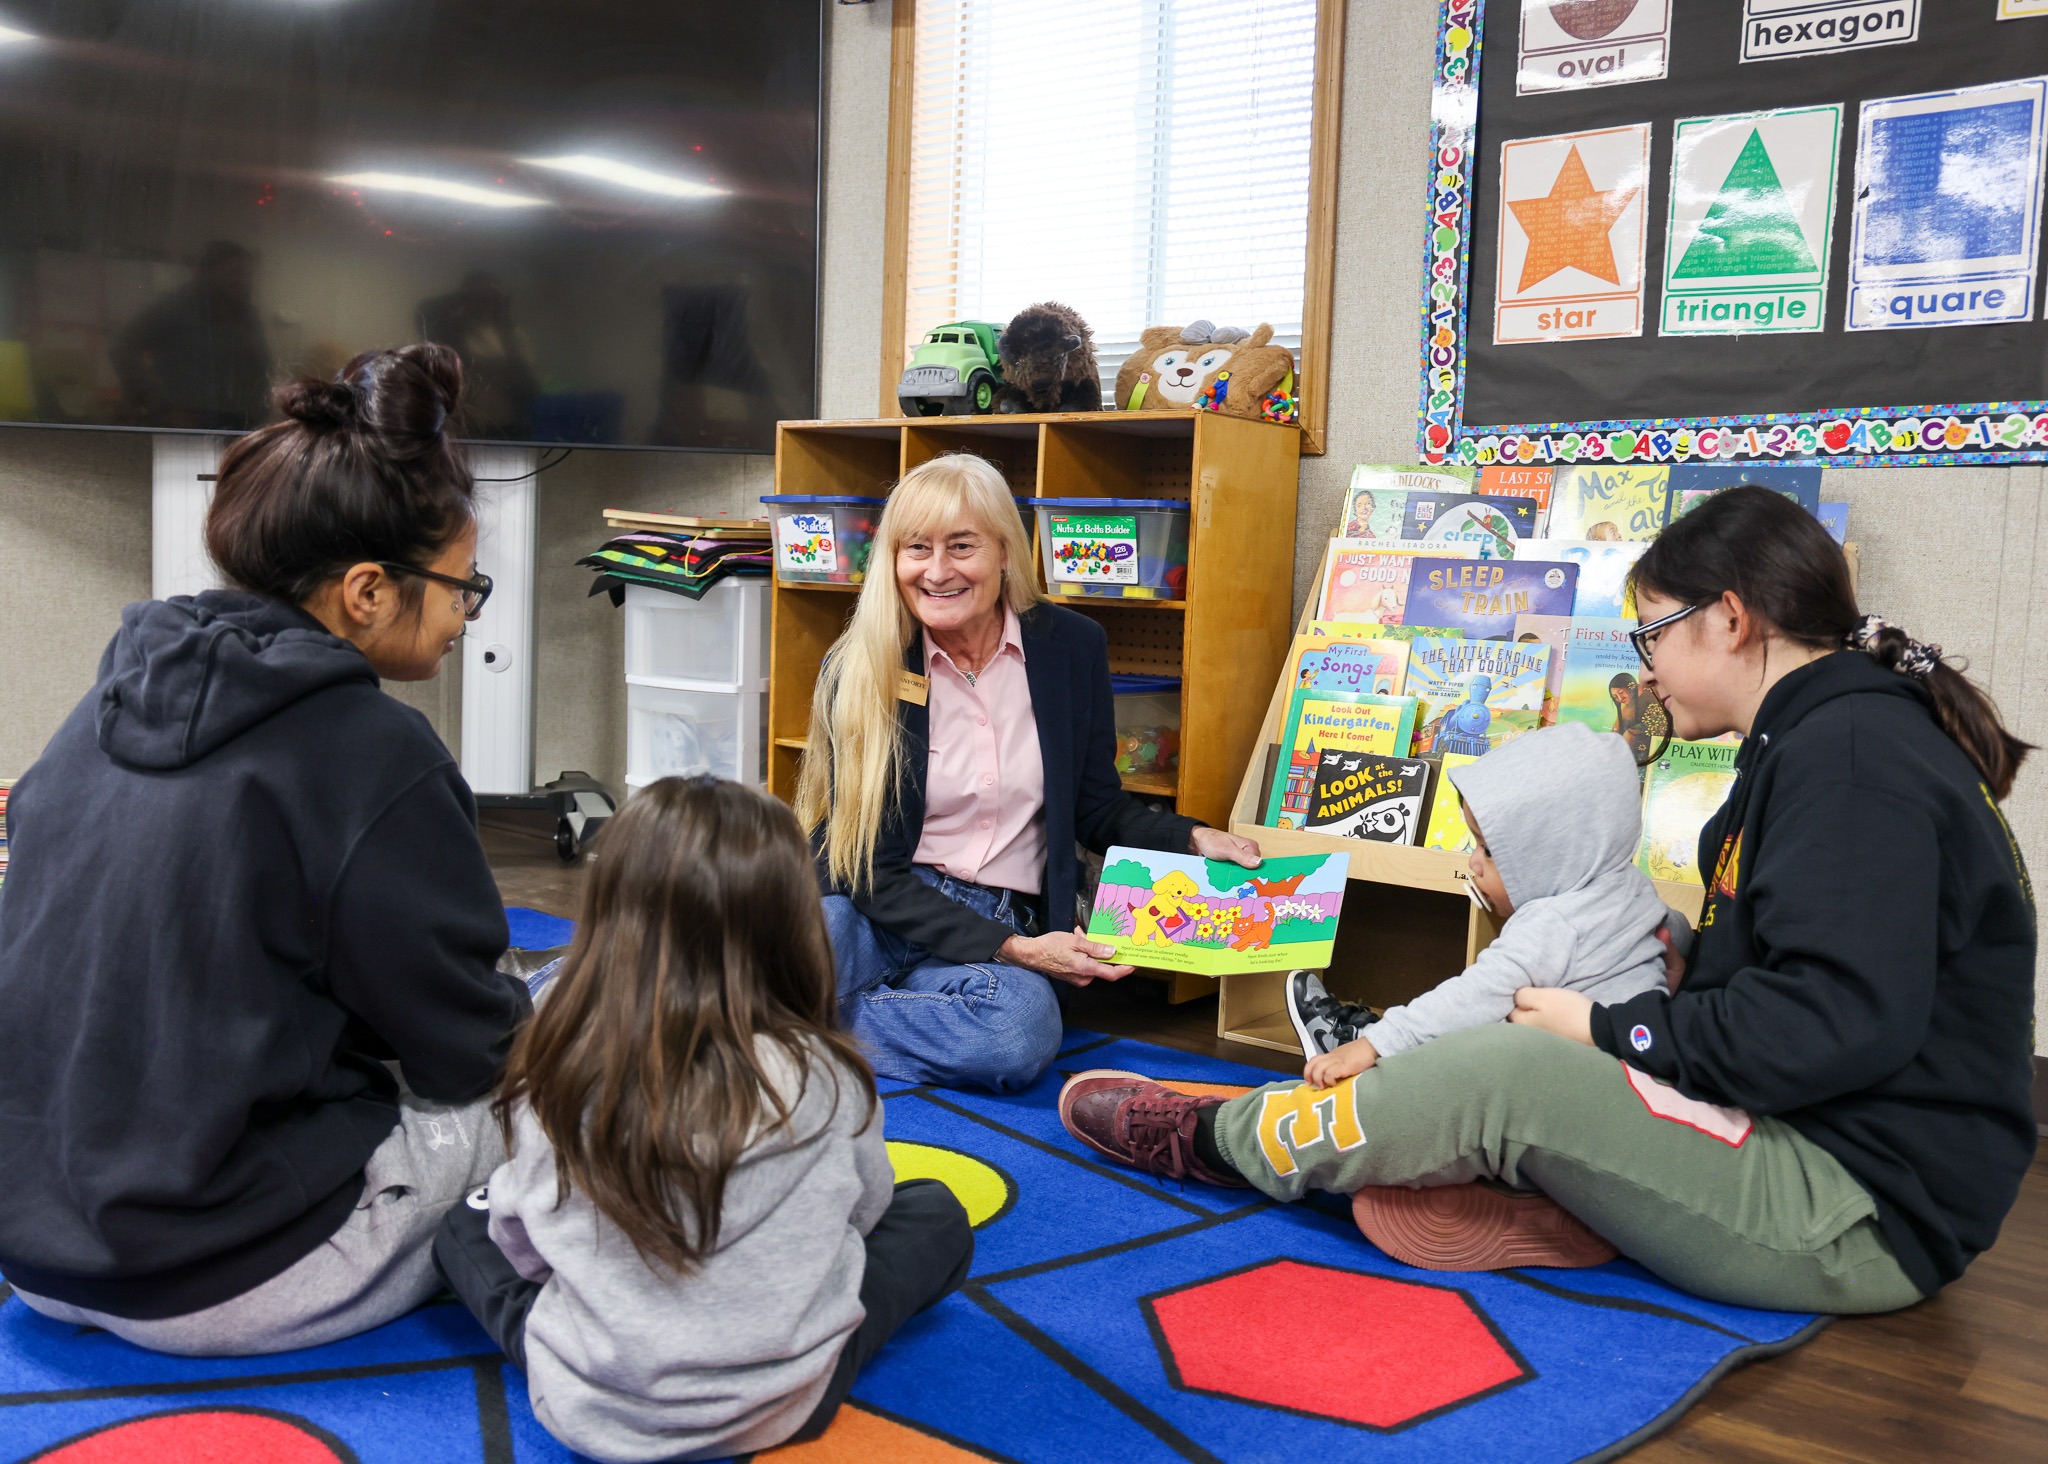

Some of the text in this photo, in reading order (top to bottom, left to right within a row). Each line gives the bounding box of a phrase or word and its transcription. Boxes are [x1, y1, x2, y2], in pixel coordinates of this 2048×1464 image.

[1754, 9, 1905, 47] hexagon
[1557, 48, 1625, 78] oval
[1676, 296, 1807, 326] triangle
[1869, 289, 2007, 320] square
[1537, 308, 1597, 331] star
[1499, 471, 1530, 485] LAST
[1487, 488, 1547, 503] MARKET
[1578, 470, 1633, 520] Max
[1604, 494, 1644, 511] and the
[1417, 505, 1433, 514] ERIC
[1056, 523, 1130, 535] Nuts & Bolts Builder
[1113, 545, 1127, 554] 128
[1358, 540, 1448, 550] RACHEL ISADORA
[1345, 553, 1376, 566] JUST
[1378, 554, 1414, 568] WANT
[1359, 567, 1398, 585] GOOD
[1428, 565, 1505, 592] SLEEP
[1460, 590, 1529, 616] TRAIN
[1576, 627, 1606, 641] First
[1328, 646, 1368, 658] My First
[1421, 647, 1444, 665] THE
[1450, 645, 1493, 661] LITTLE
[1497, 648, 1544, 673] ENGINE
[1320, 657, 1374, 685] Songs
[1441, 658, 1520, 678] THAT COULD
[1331, 705, 1371, 715] Look Out
[1318, 729, 1338, 740] Here
[1346, 731, 1374, 742] Come!
[1671, 744, 1705, 760] PLAY
[1320, 762, 1385, 799] LOOK at
[1377, 769, 1394, 779] the
[1317, 779, 1403, 819] ANIMALS!
